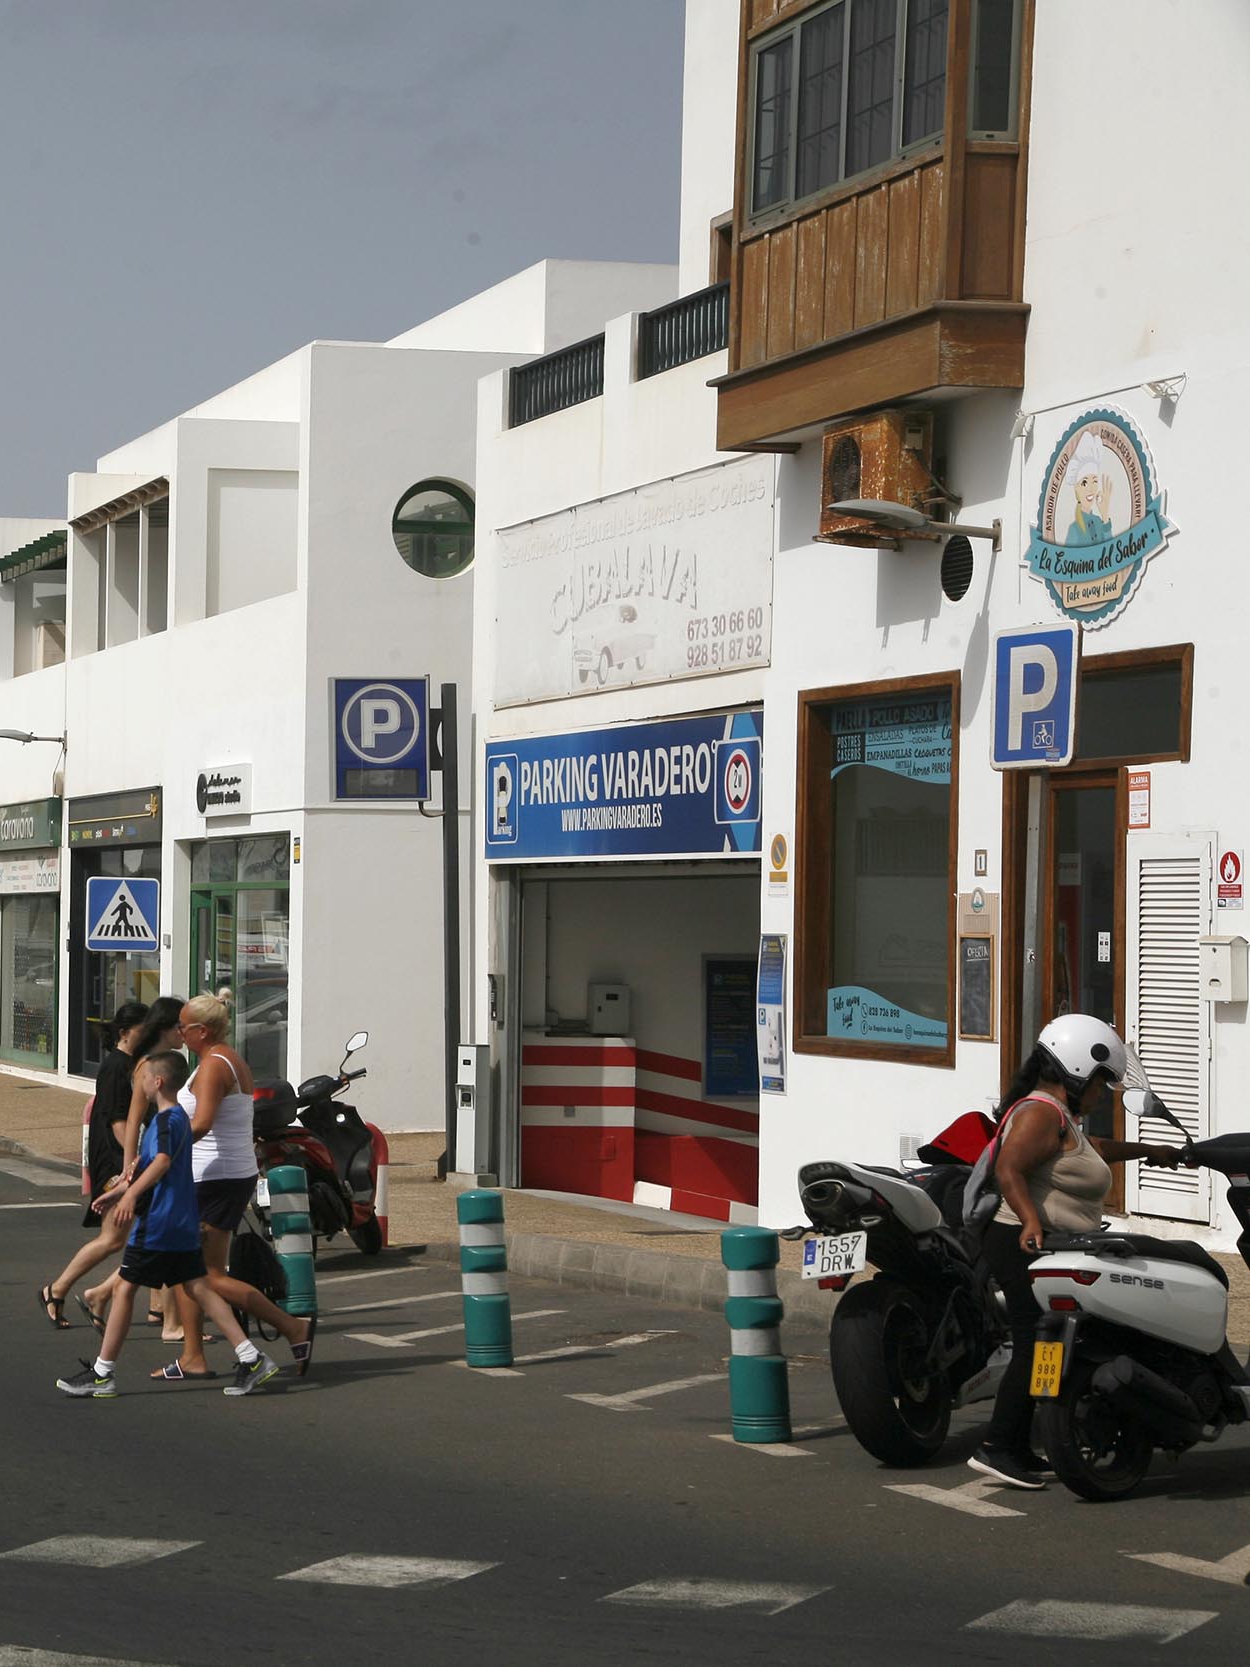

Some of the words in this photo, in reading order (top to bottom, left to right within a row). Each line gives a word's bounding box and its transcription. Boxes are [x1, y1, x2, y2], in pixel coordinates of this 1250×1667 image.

[1128, 460, 1139, 483] PARA
[1045, 495, 1055, 531] ASADOR
[1052, 484, 1058, 494] DE
[1056, 453, 1070, 481] POLLO
[1039, 547, 1052, 572] La
[1054, 550, 1095, 579] Esquina
[1097, 545, 1114, 571] del
[1115, 532, 1148, 564] Sabor
[550, 544, 698, 636] CUBALAVA
[1066, 584, 1080, 603] Take
[1081, 586, 1101, 598] away
[1102, 574, 1119, 597] food
[687, 618, 709, 641] 673
[711, 613, 726, 636] 30
[729, 610, 745, 633] 66
[747, 607, 763, 629] 60
[687, 645, 709, 668] 928
[711, 641, 726, 664] 51
[728, 638, 744, 661] 87
[747, 634, 763, 657] 92
[1008, 644, 1059, 751] P
[360, 699, 401, 748] P
[872, 709, 901, 724] POLLO
[903, 703, 934, 721] ASADO
[836, 735, 862, 749] POSTRES
[868, 728, 904, 743] ENSALADAS
[836, 748, 862, 762] CASEROS
[867, 748, 912, 761] EMPANADILLAS
[520, 754, 598, 807] PARKING
[601, 742, 711, 800] VARADERO
[0, 816, 34, 841] caravana
[561, 802, 662, 833] WWW.PARKINGVARADERO.ES
[966, 945, 990, 959] OFERTA
[821, 1235, 862, 1256] 1557
[821, 1253, 854, 1273] DRW
[1110, 1273, 1165, 1290] sense
[1042, 1350, 1053, 1361] C1
[1037, 1363, 1056, 1375] 988
